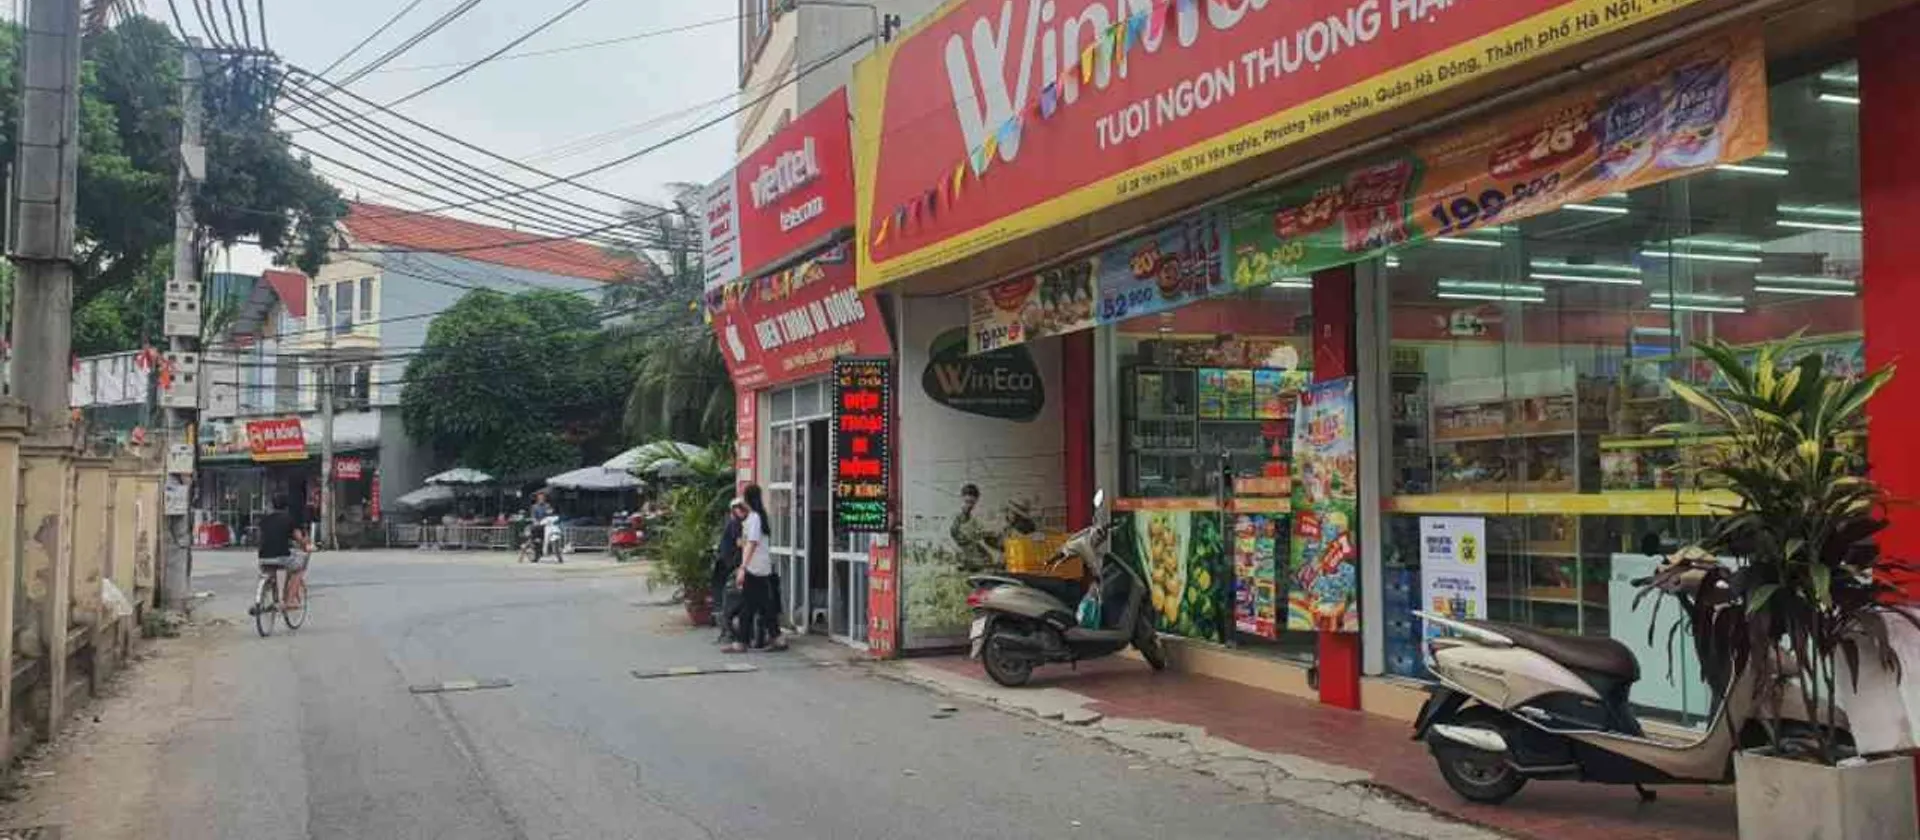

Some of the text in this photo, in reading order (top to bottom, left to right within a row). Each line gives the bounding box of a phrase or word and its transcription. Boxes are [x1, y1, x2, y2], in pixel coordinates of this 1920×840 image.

[1416, 73, 1434, 91] Hà
[1437, 56, 1482, 84] Đông,
[1486, 34, 1535, 64] Thành
[1536, 21, 1571, 51] phố
[1574, 10, 1602, 33] Hà
[1154, 61, 1237, 126] NGON
[934, 362, 1034, 396] WinEco
